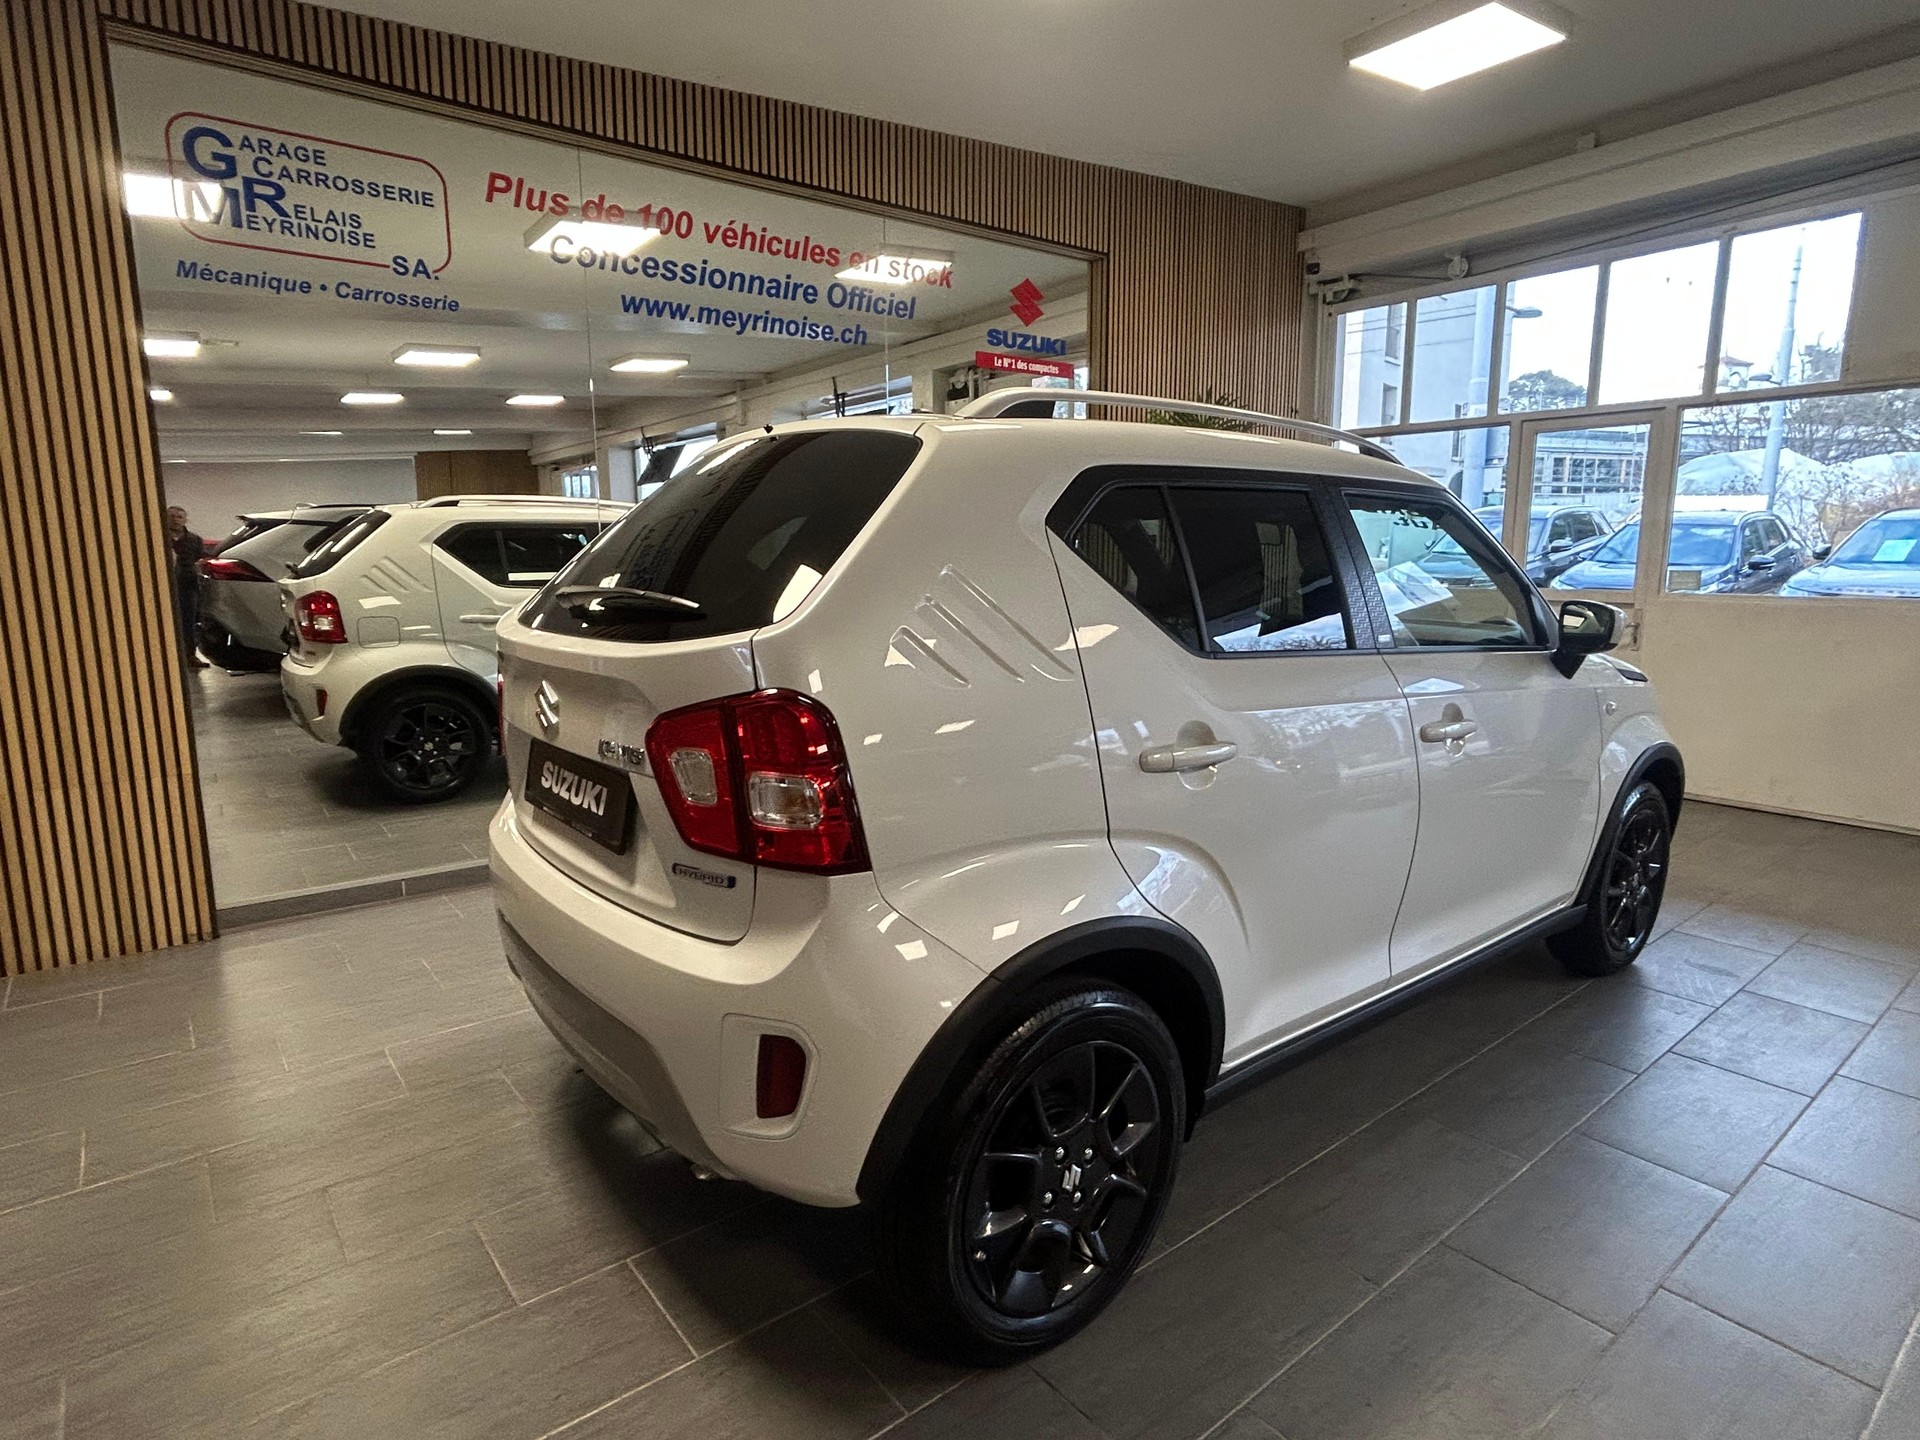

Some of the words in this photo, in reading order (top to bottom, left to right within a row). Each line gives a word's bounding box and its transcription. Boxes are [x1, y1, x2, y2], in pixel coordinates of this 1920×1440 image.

[182, 126, 327, 180] GARAGE
[241, 176, 362, 230] RELAIS
[252, 155, 435, 208] CARROSSERIE
[485, 171, 570, 216] Plus
[581, 193, 626, 222] de
[638, 203, 693, 239] 100
[703, 217, 840, 267] véhicules
[849, 251, 880, 274] en
[888, 257, 954, 289] stock
[176, 259, 312, 295] Mécanique
[335, 281, 460, 313] Carrosserie
[391, 255, 440, 280] SA.
[550, 235, 818, 304] Concessionnaire
[827, 282, 917, 320] Officiel
[621, 295, 867, 346] www.meyrinoise.ch
[986, 328, 1067, 356] SUZUKI
[994, 356, 1003, 367] Le
[1016, 359, 1028, 371] des
[541, 761, 608, 817] SUZUKI
[679, 868, 725, 885] HYBRID
